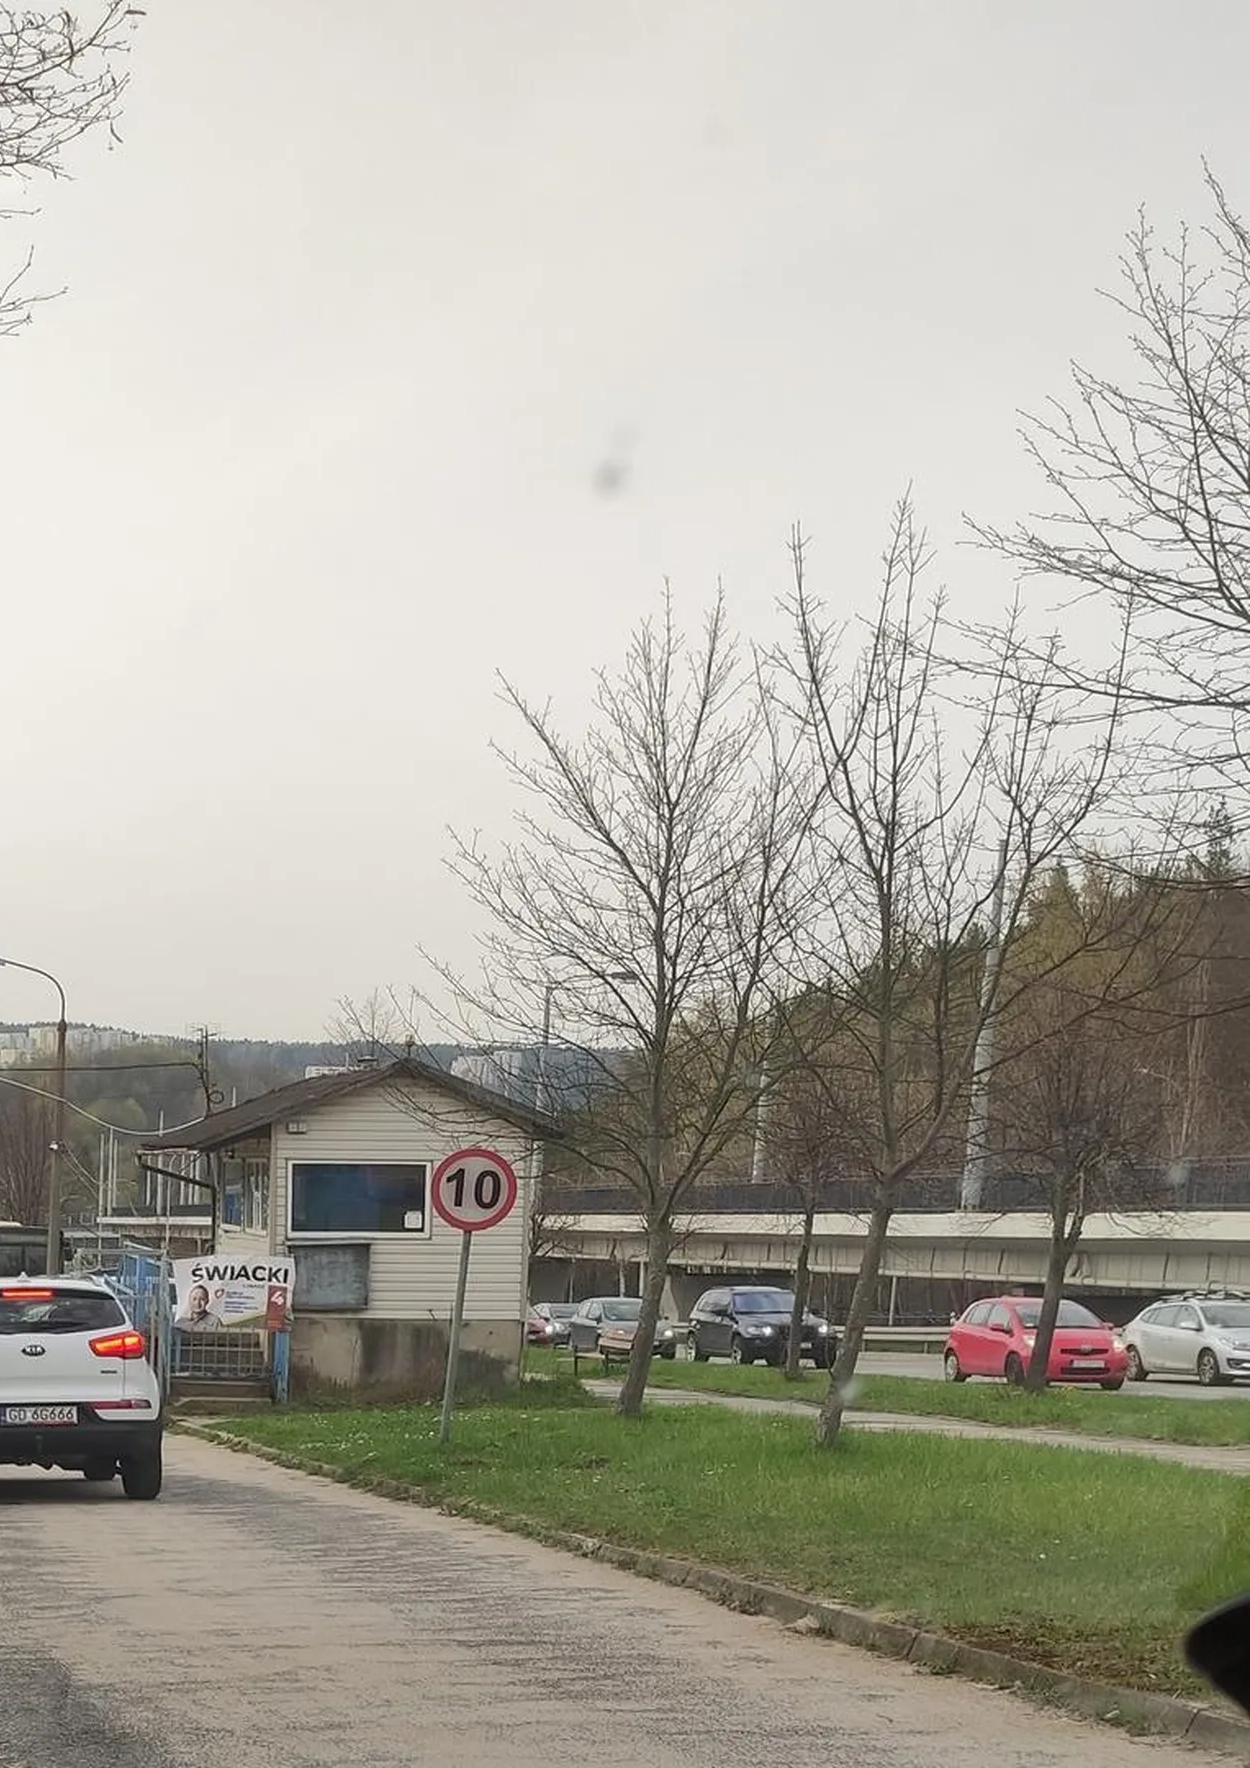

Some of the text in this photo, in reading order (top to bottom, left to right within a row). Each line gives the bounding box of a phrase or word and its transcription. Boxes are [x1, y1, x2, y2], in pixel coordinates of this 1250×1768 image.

[446, 1168, 501, 1209] 10
[191, 1263, 289, 1283] ŚWIACKI
[270, 1291, 284, 1305] 4
[8, 1407, 74, 1421] GD 6G666
